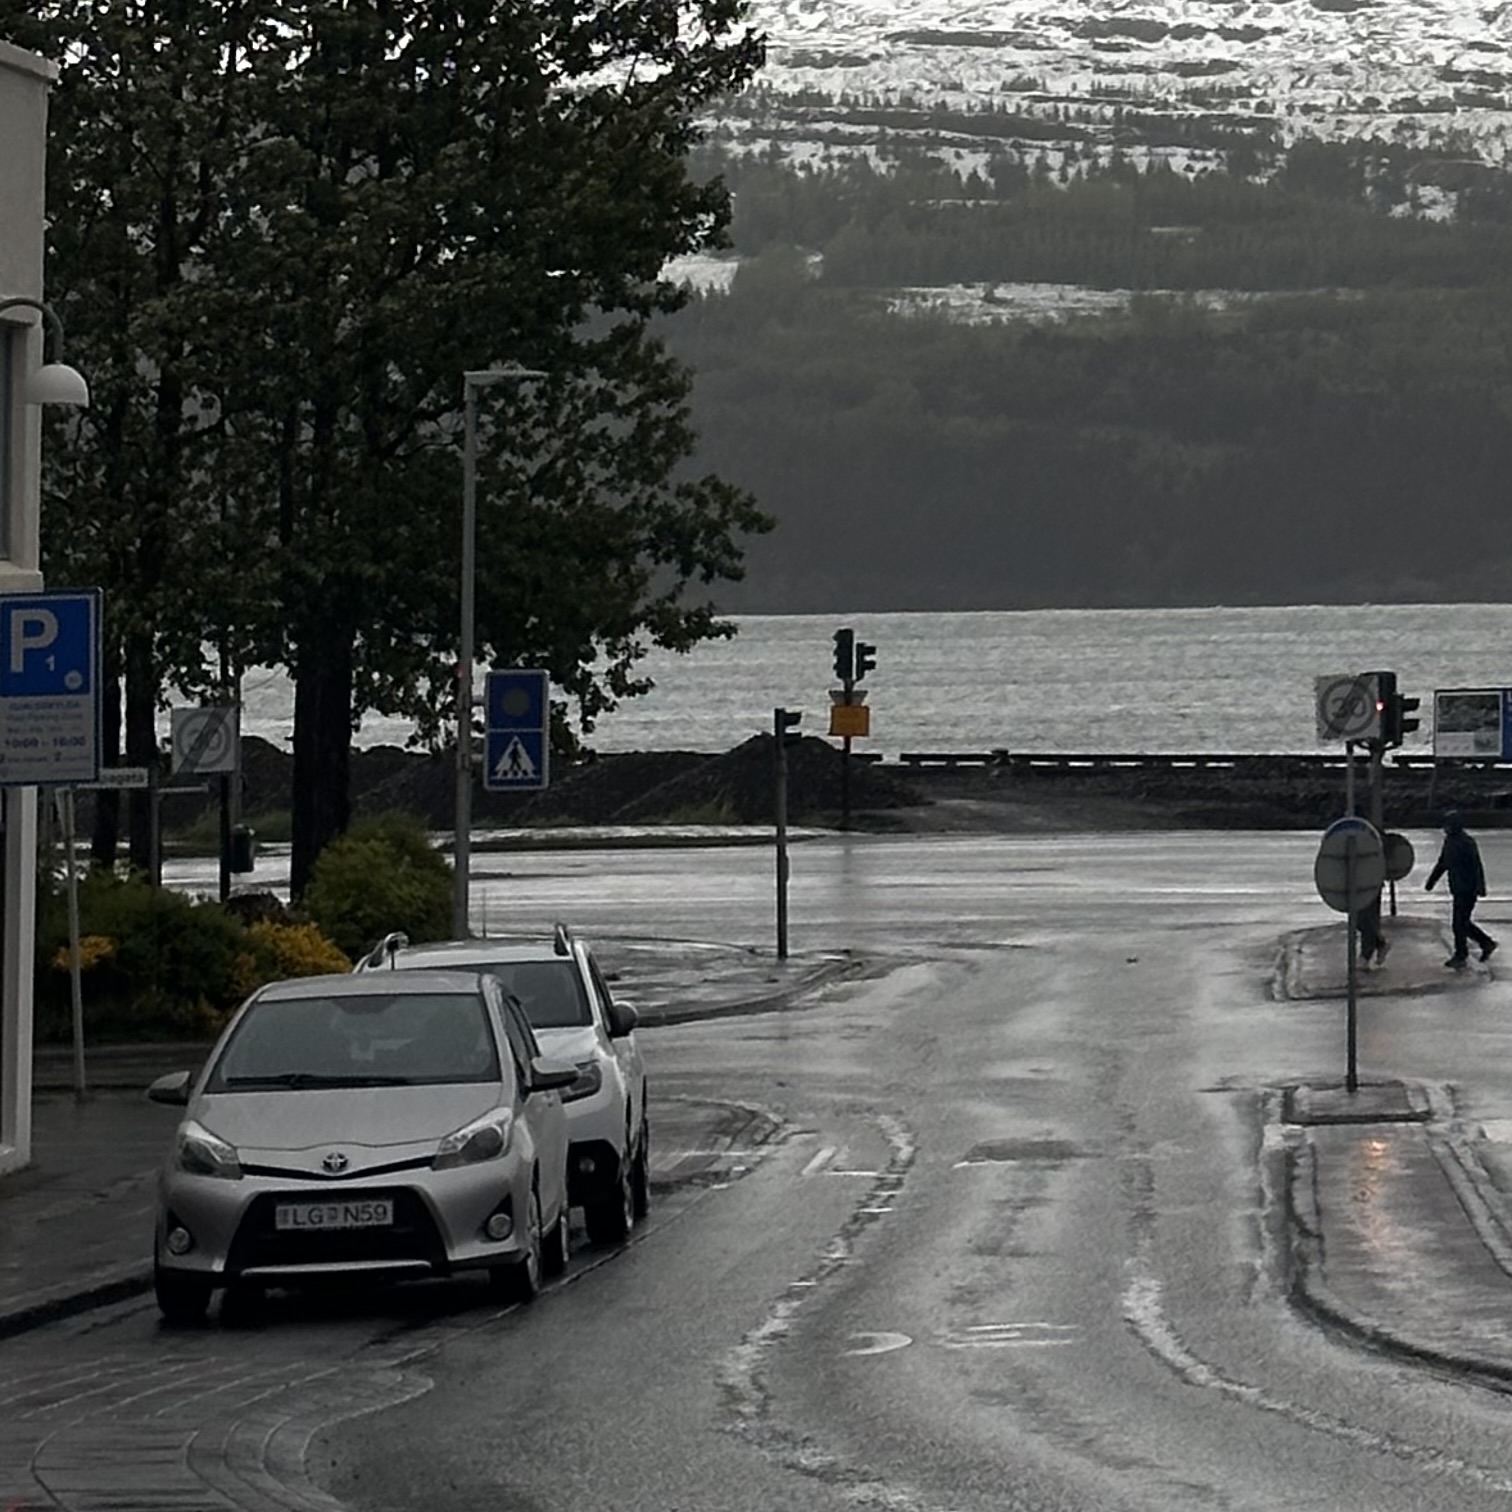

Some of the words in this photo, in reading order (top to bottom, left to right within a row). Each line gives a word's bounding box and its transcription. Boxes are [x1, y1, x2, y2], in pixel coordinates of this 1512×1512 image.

[10, 608, 59, 673] P
[44, 655, 55, 672] 1
[293, 1207, 323, 1226] LG
[344, 1203, 388, 1223] N59
